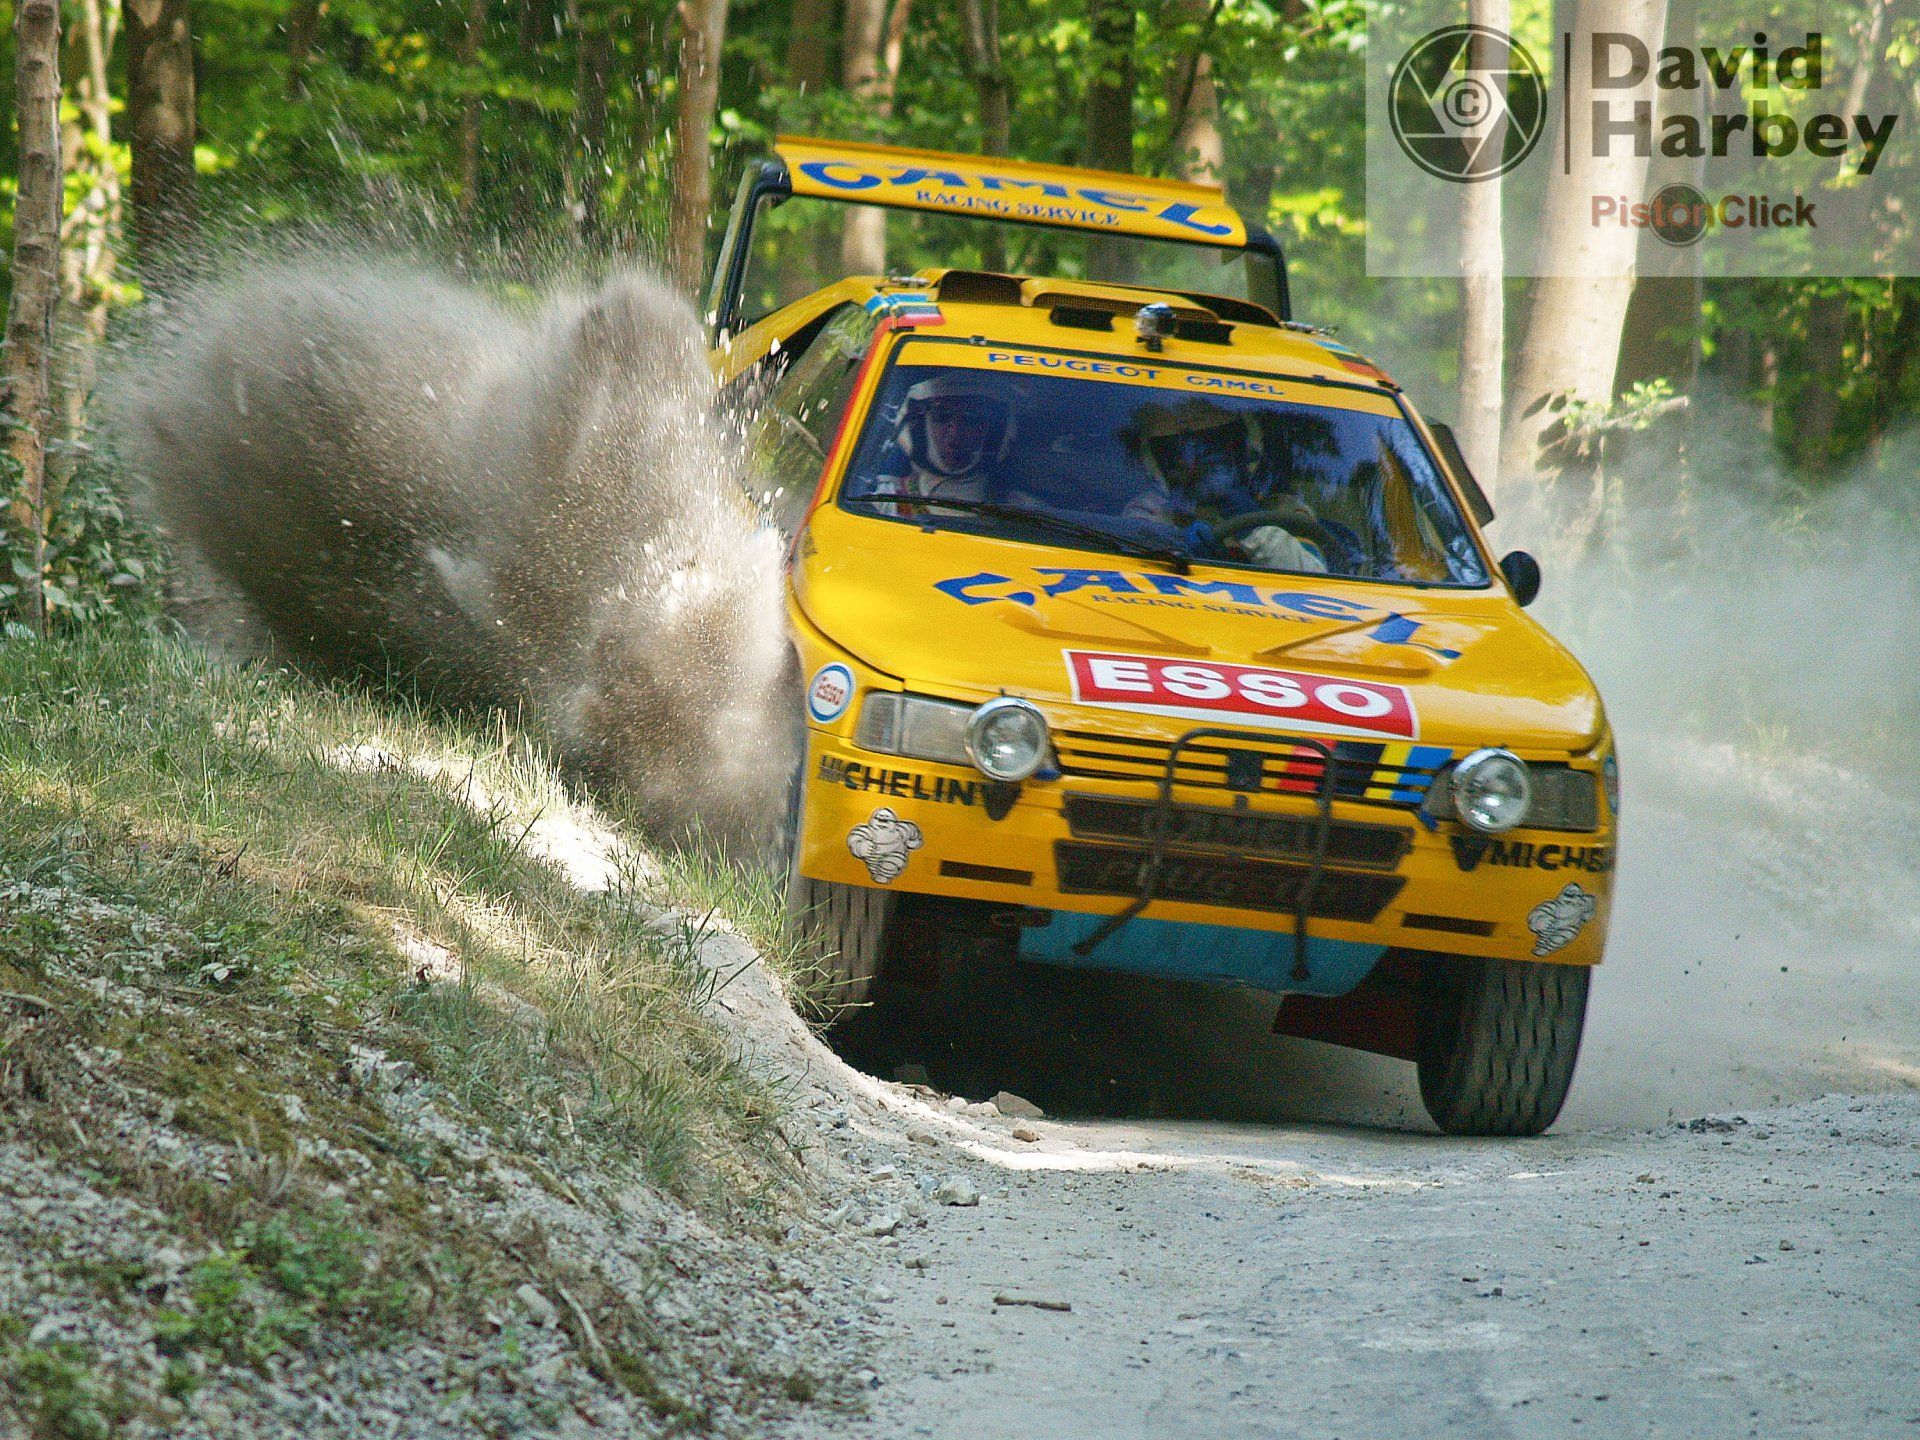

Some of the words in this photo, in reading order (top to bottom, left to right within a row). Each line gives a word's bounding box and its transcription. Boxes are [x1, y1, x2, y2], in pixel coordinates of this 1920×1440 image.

[800, 161, 1232, 236] CAMEL
[916, 190, 1010, 214] RACING
[1018, 203, 1121, 226] SERVICE
[988, 353, 1161, 380] PEUGEOT
[1186, 375, 1285, 395] CAMEL
[933, 567, 1463, 660] CAMEL
[1092, 594, 1196, 610] RACING
[1202, 604, 1318, 624] SERVICE
[1086, 657, 1394, 719] ESSO
